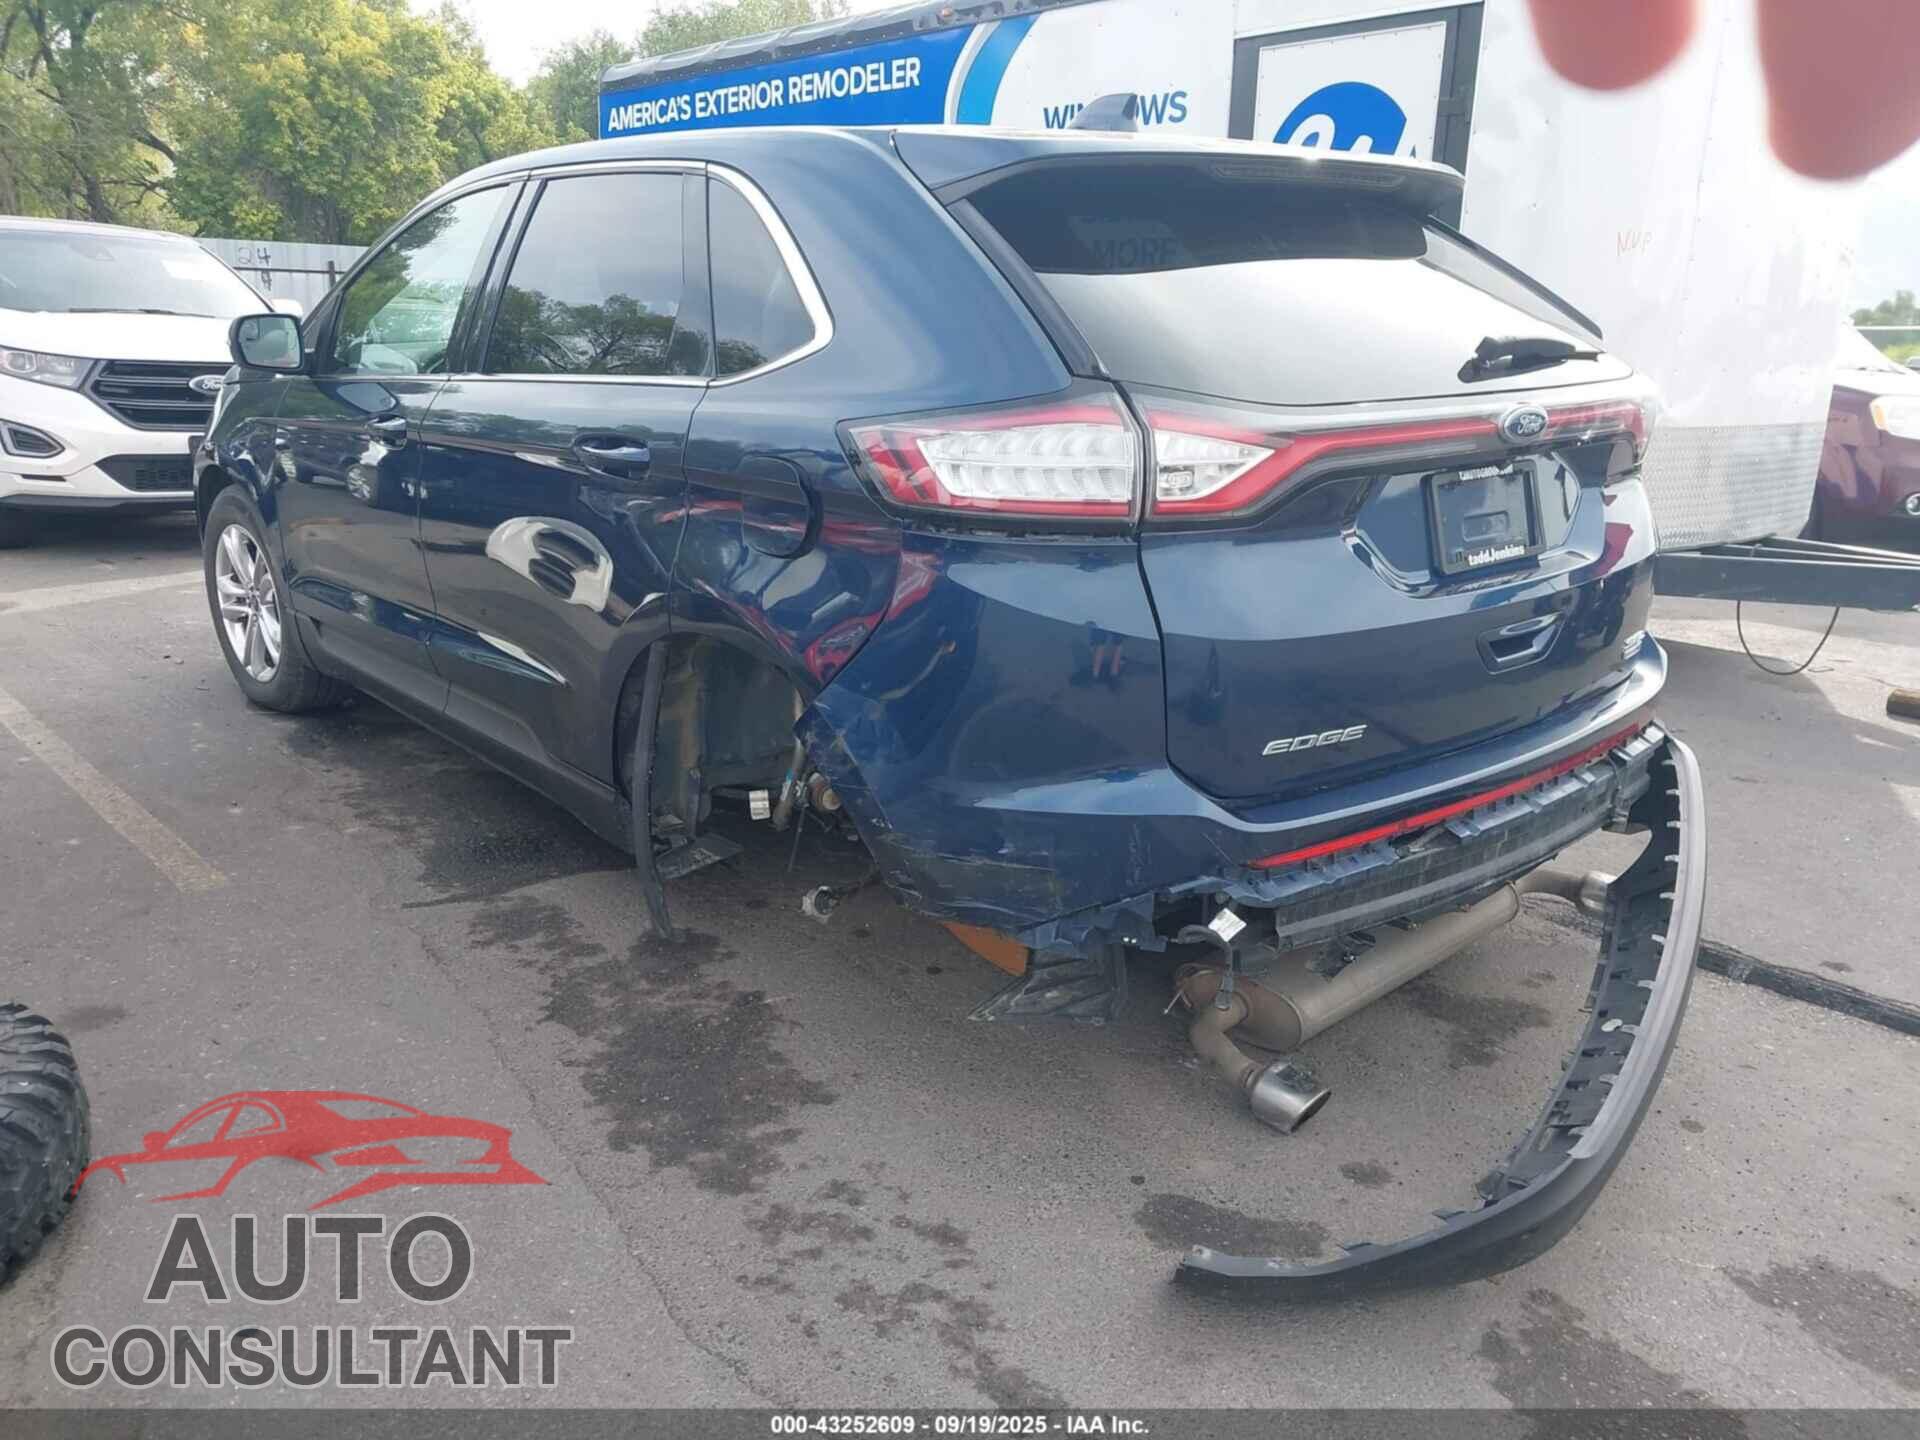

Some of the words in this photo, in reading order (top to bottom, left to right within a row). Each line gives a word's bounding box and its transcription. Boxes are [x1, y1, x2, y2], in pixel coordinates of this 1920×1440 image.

[608, 94, 692, 132] AMERICA'S
[694, 79, 784, 118] EXTERIOR
[788, 56, 921, 104] REMODELER
[1262, 724, 1368, 756] EDGE
